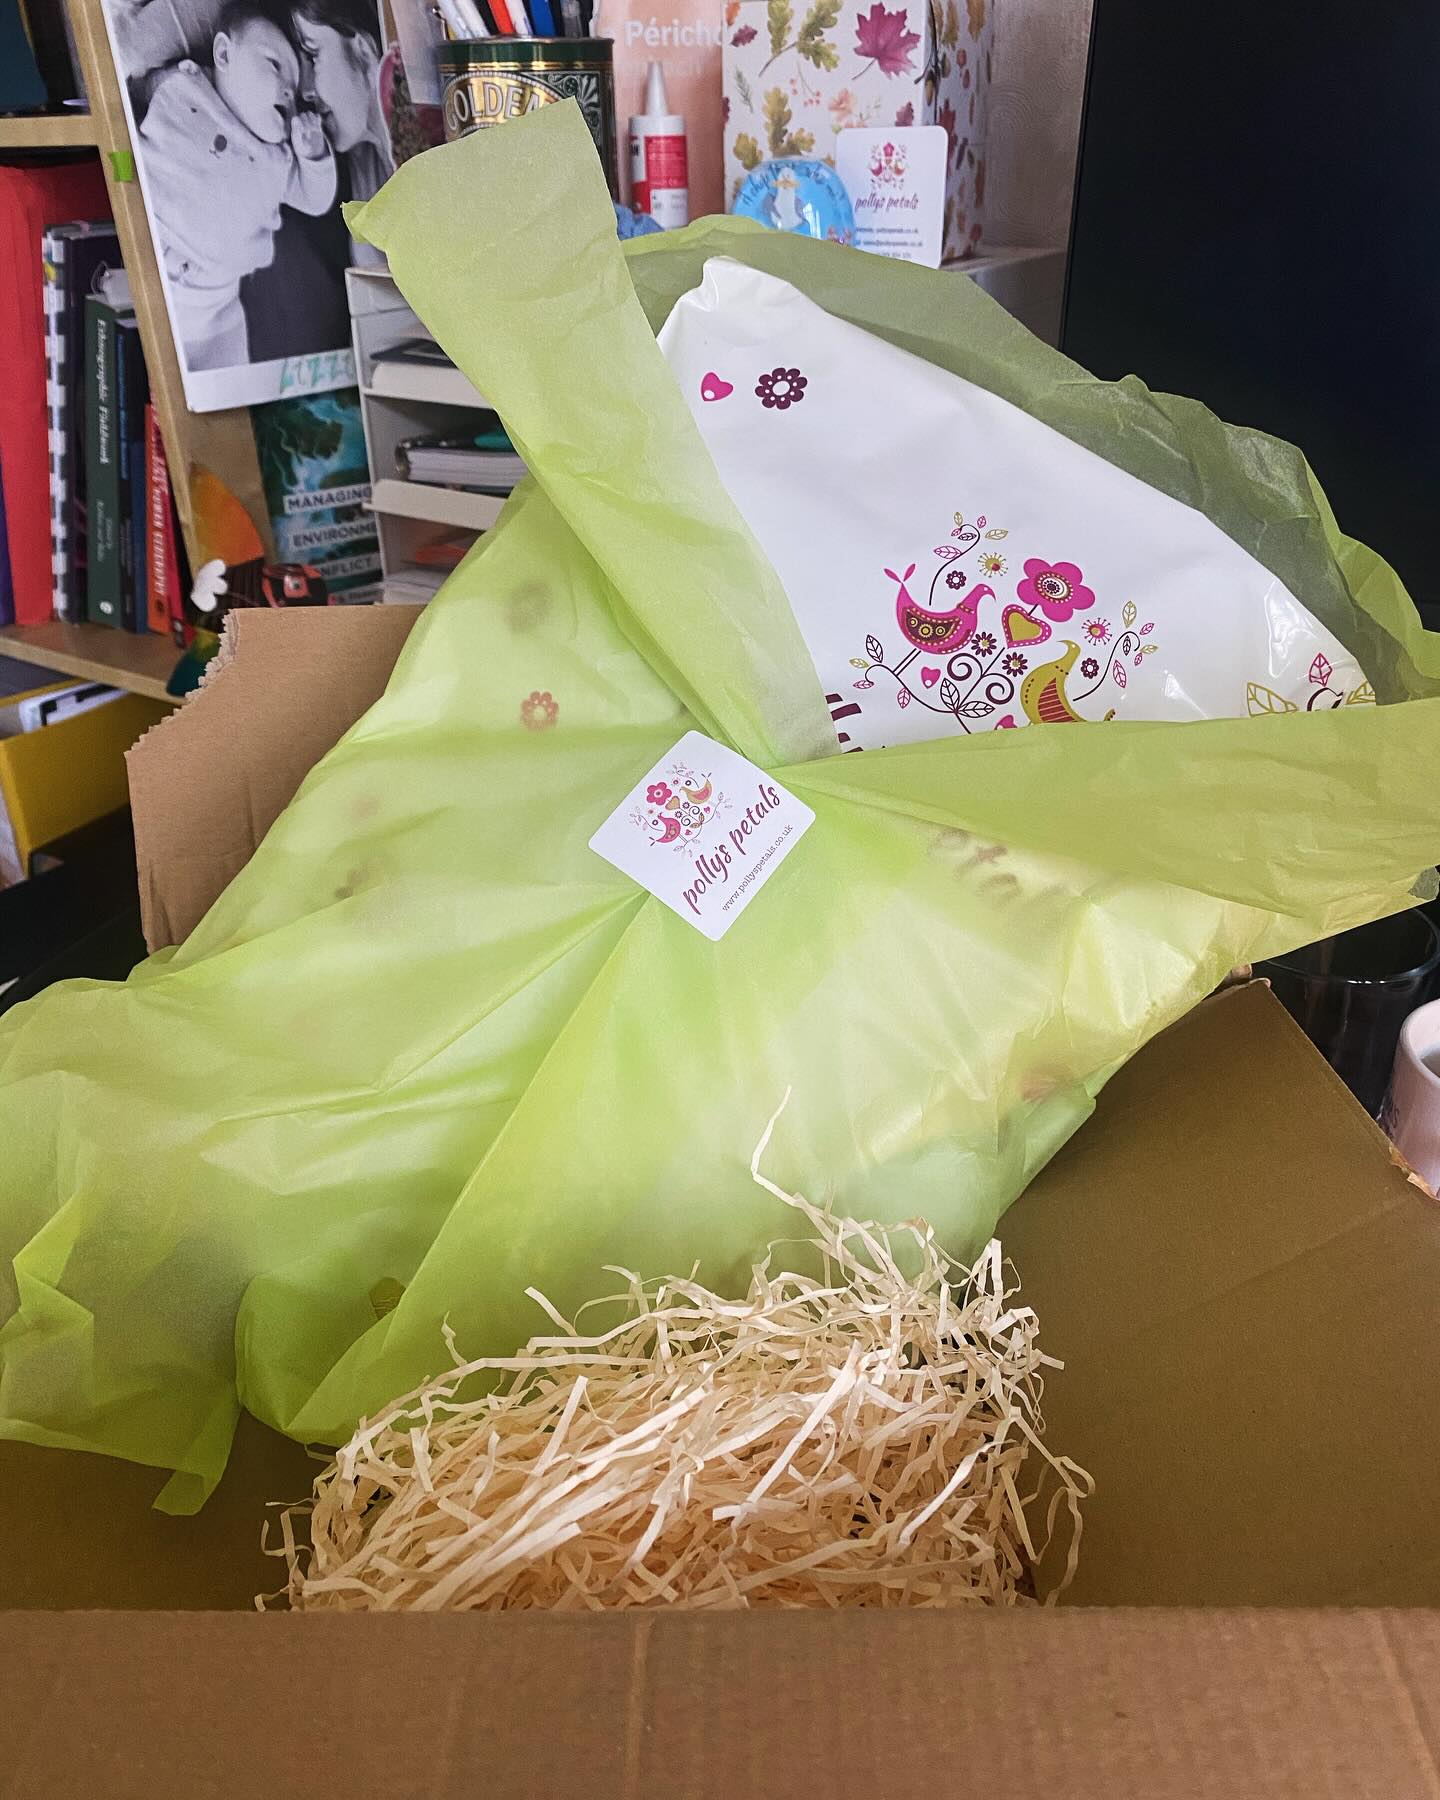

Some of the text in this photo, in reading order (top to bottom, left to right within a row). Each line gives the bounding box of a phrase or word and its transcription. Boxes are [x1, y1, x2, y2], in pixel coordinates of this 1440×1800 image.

[682, 783, 781, 916] polly's petals
[722, 824, 794, 912] www.pollyspetals.co.uk
